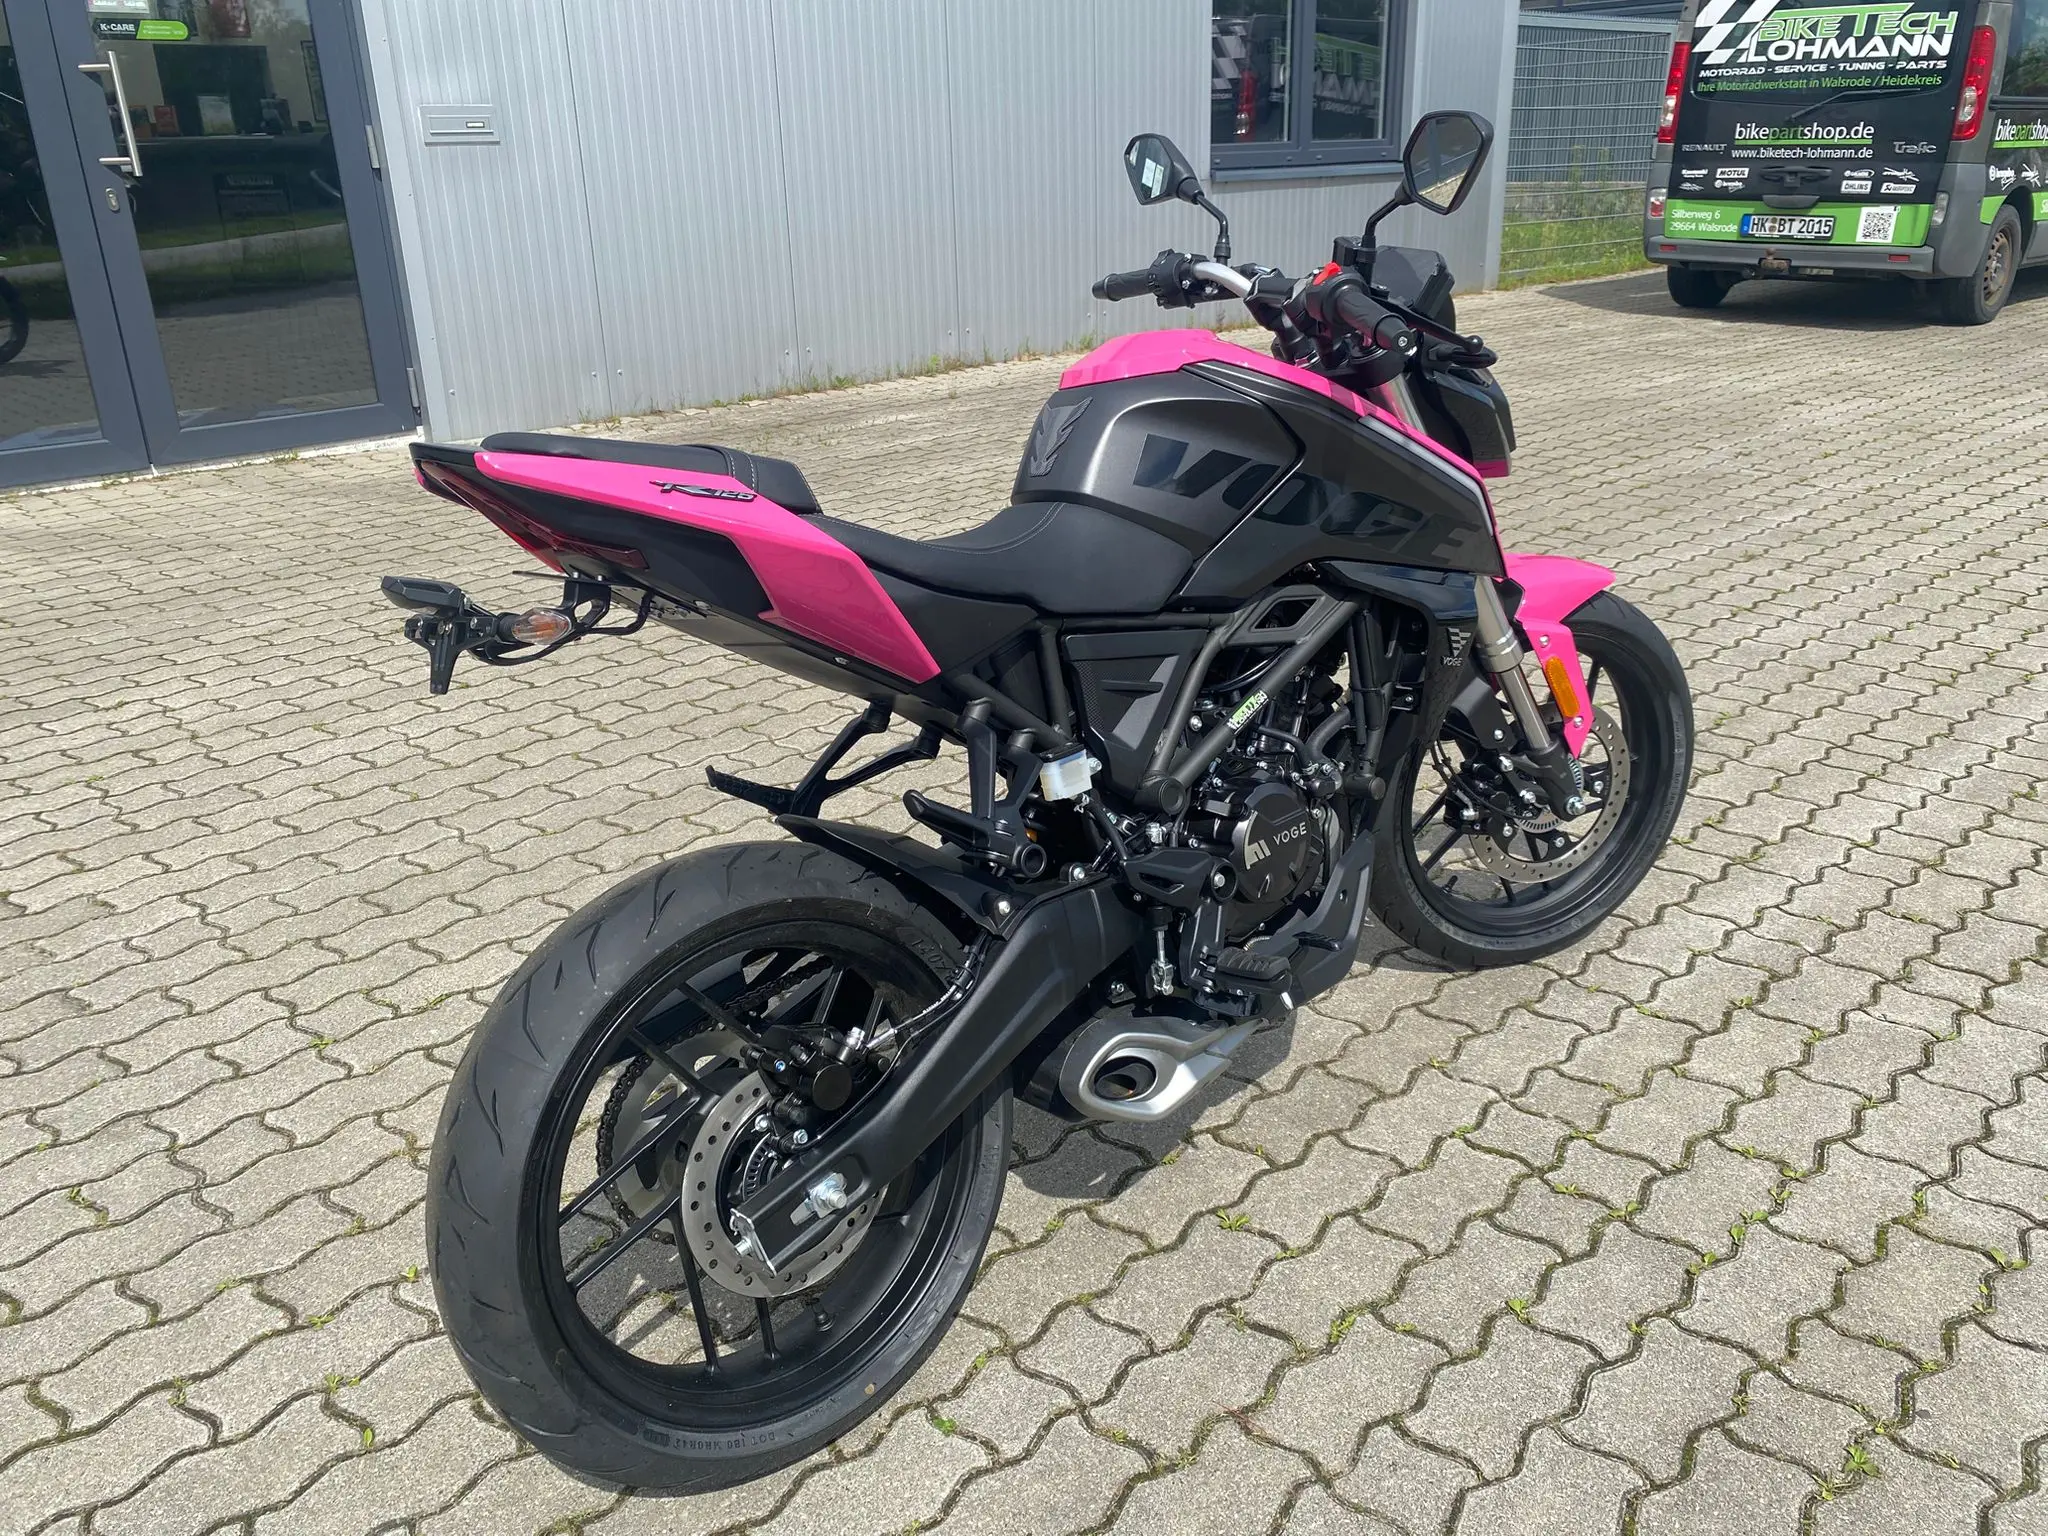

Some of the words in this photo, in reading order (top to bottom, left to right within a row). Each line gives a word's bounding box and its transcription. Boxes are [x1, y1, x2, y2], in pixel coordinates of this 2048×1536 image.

[1758, 16, 1843, 42] BIKE
[1746, 24, 1954, 62] LOHMANN
[1699, 66, 1766, 77] MOTORRAD
[1773, 63, 1828, 73] SERVICE
[1838, 61, 1885, 71] TUNING
[1896, 60, 1947, 69] PARTS
[1697, 81, 1716, 92] Ihre
[1716, 79, 1806, 91] Motorradwerkstatt
[1808, 79, 1819, 88] in
[1821, 76, 1871, 87] Walsrode
[1881, 74, 1942, 86] Heidekreis
[1734, 121, 1875, 142] bikepartshop.de
[1682, 143, 1727, 152] RENAULT
[1731, 146, 1874, 159] www.biketech-lohmann.de
[1893, 141, 1937, 154] Trafic
[1671, 209, 1712, 220] Silberweg
[1714, 210, 1721, 219] 6
[1670, 222, 1696, 231] 29664
[1698, 222, 1738, 232] Walsrode
[1751, 217, 1769, 232] HK
[1778, 218, 1795, 233] BT
[1797, 219, 1833, 234] 2015
[1132, 433, 1483, 566] VOGE
[1442, 655, 1463, 666] VOGE
[1273, 821, 1307, 845] VOGE
